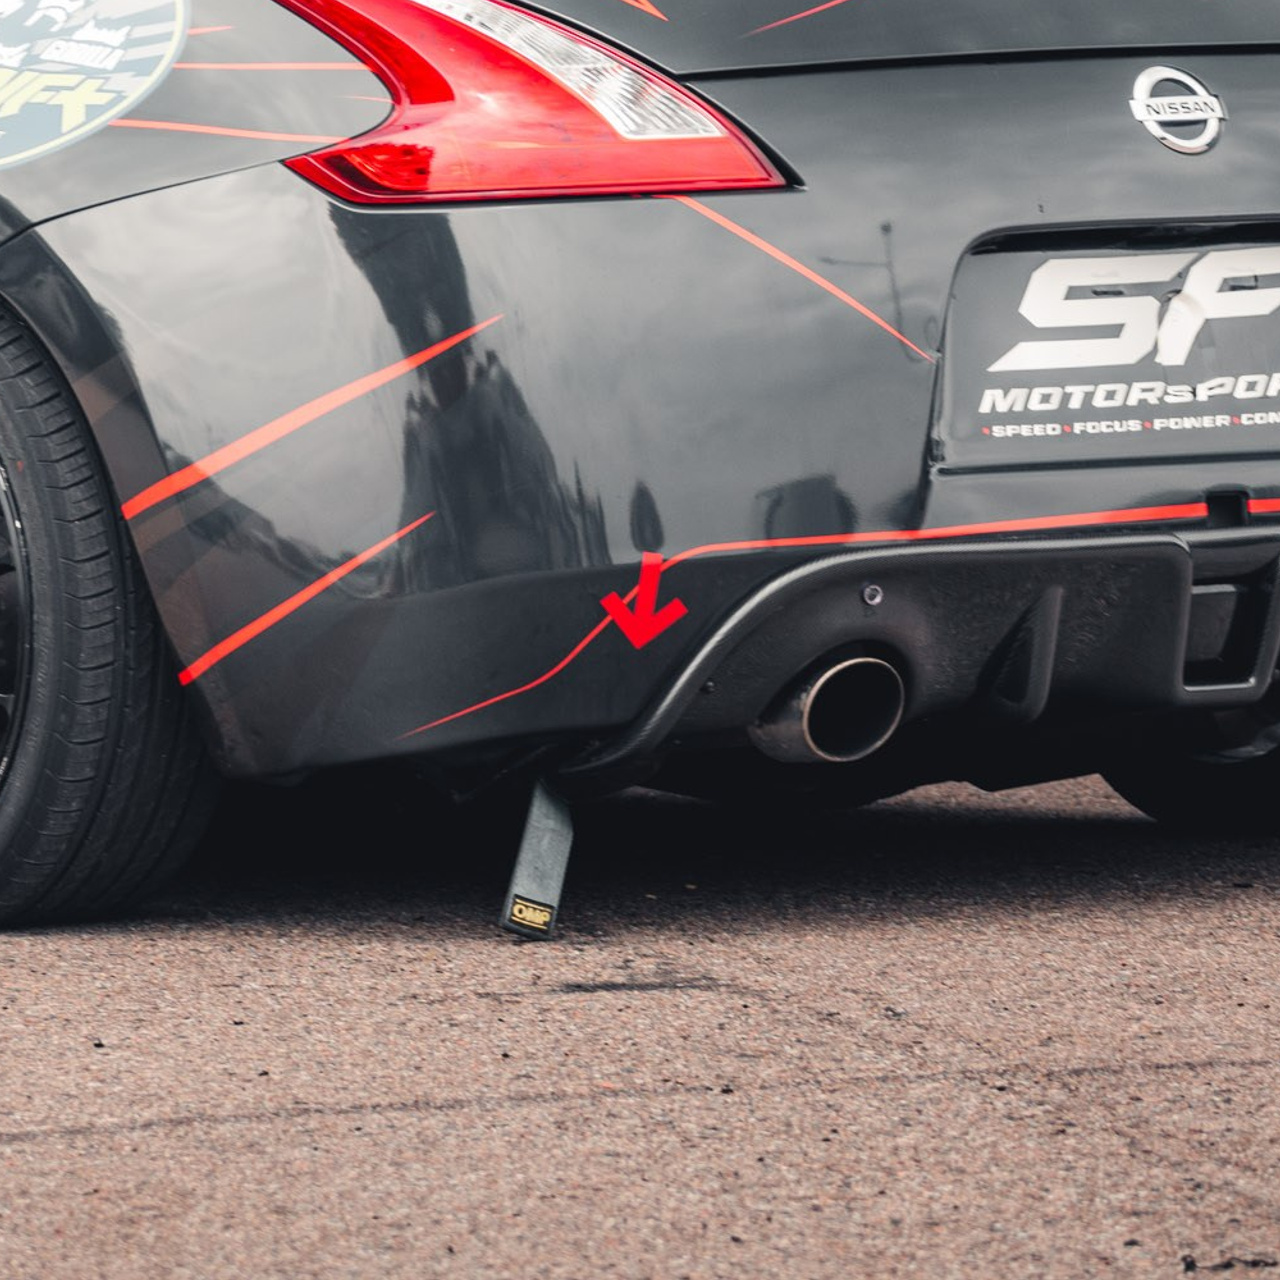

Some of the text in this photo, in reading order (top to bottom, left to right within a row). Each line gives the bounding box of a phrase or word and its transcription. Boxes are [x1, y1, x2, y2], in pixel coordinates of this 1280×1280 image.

[1145, 99, 1218, 117] NISSAN
[985, 247, 1280, 373] SF
[991, 422, 1063, 438] SPEED
[1073, 419, 1143, 435] FOCUS
[1152, 414, 1232, 432] POWER
